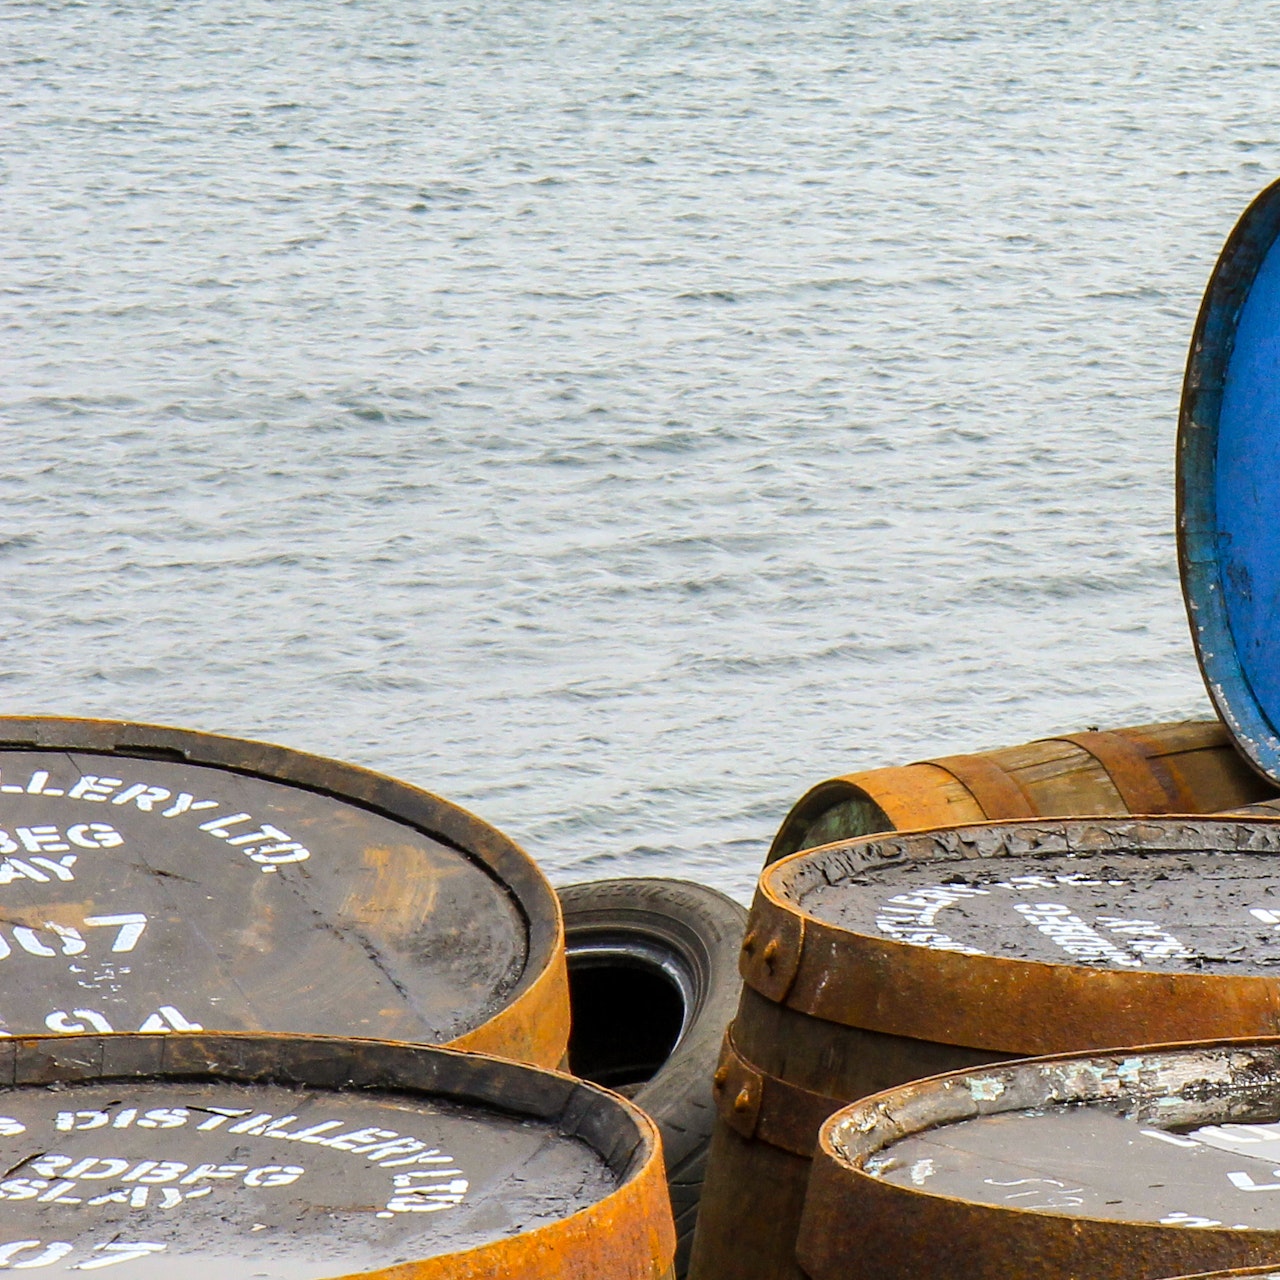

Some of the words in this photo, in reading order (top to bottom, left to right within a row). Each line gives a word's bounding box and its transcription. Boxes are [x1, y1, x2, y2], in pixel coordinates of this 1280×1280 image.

[0, 913, 148, 961] 07
[54, 1106, 453, 1168] DISTILLERY
[0, 1178, 213, 1209] SLAY
